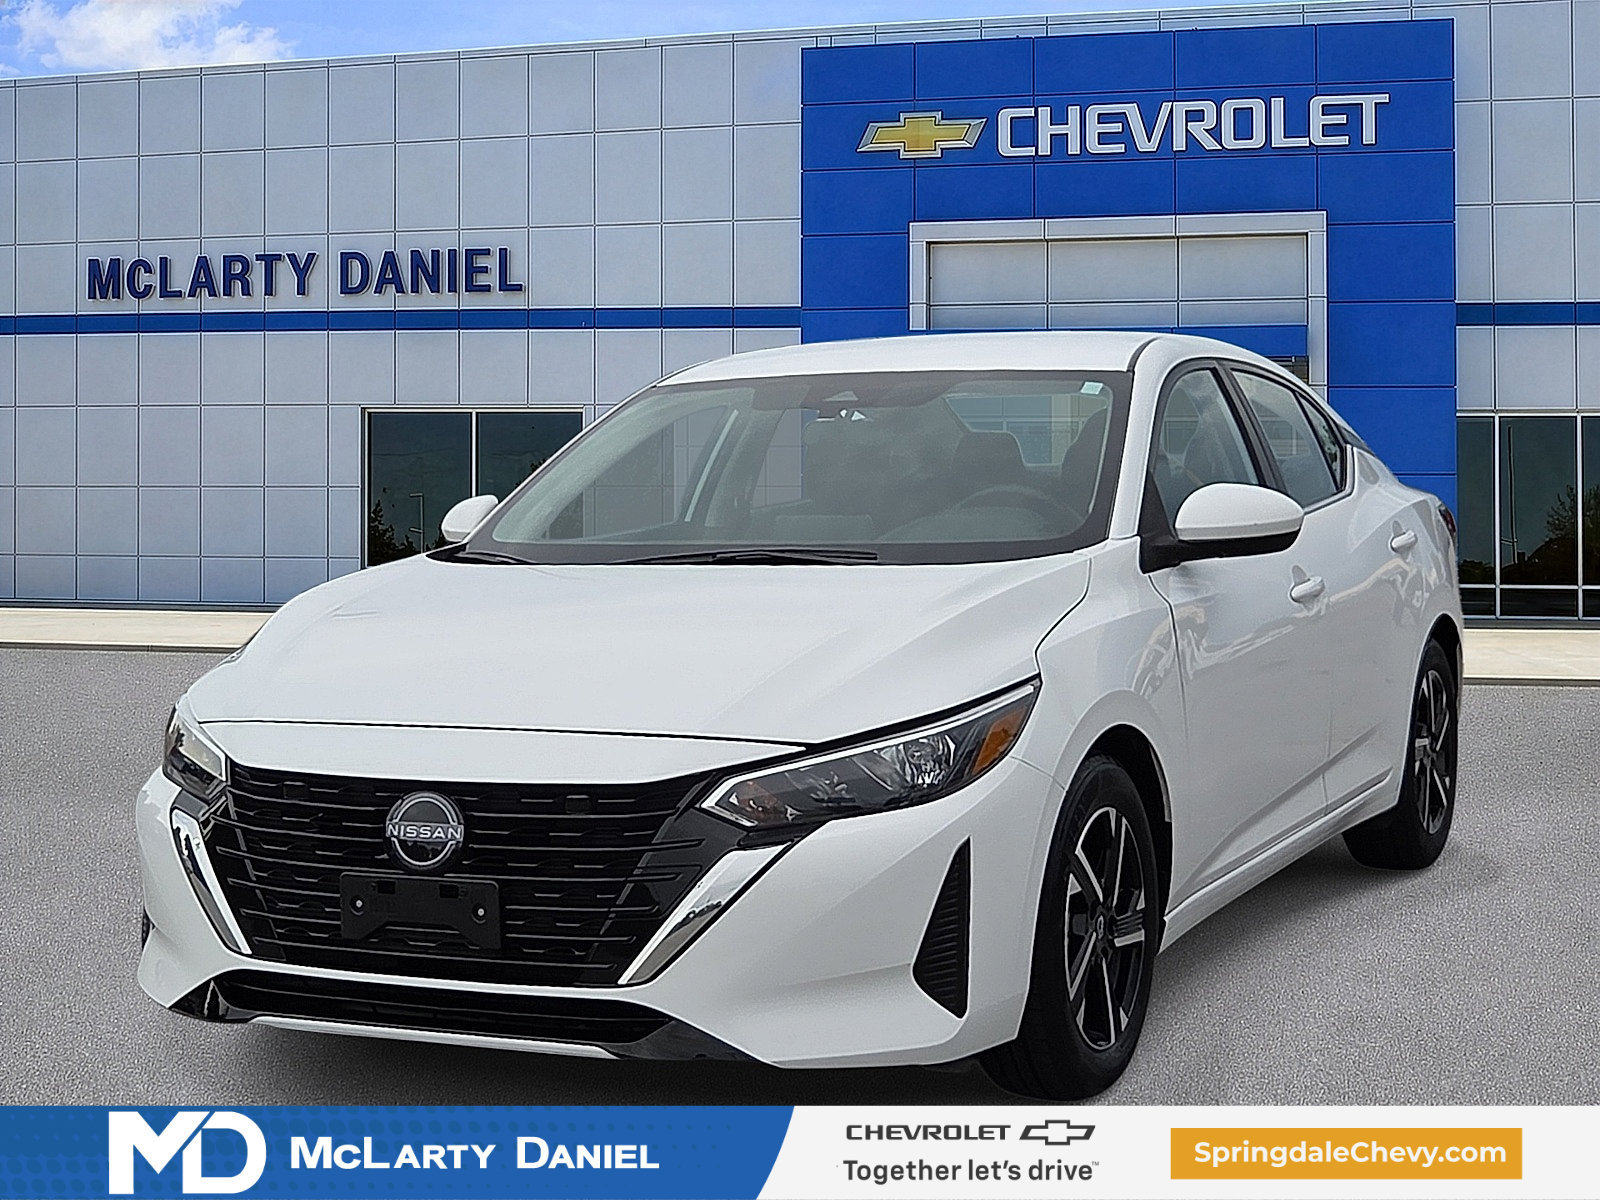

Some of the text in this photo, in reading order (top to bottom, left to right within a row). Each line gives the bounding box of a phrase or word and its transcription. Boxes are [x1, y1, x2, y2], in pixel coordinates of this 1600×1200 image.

[997, 93, 1390, 157] CHEVROLET
[339, 247, 525, 295] DANIEL
[387, 823, 462, 839] NISSAN
